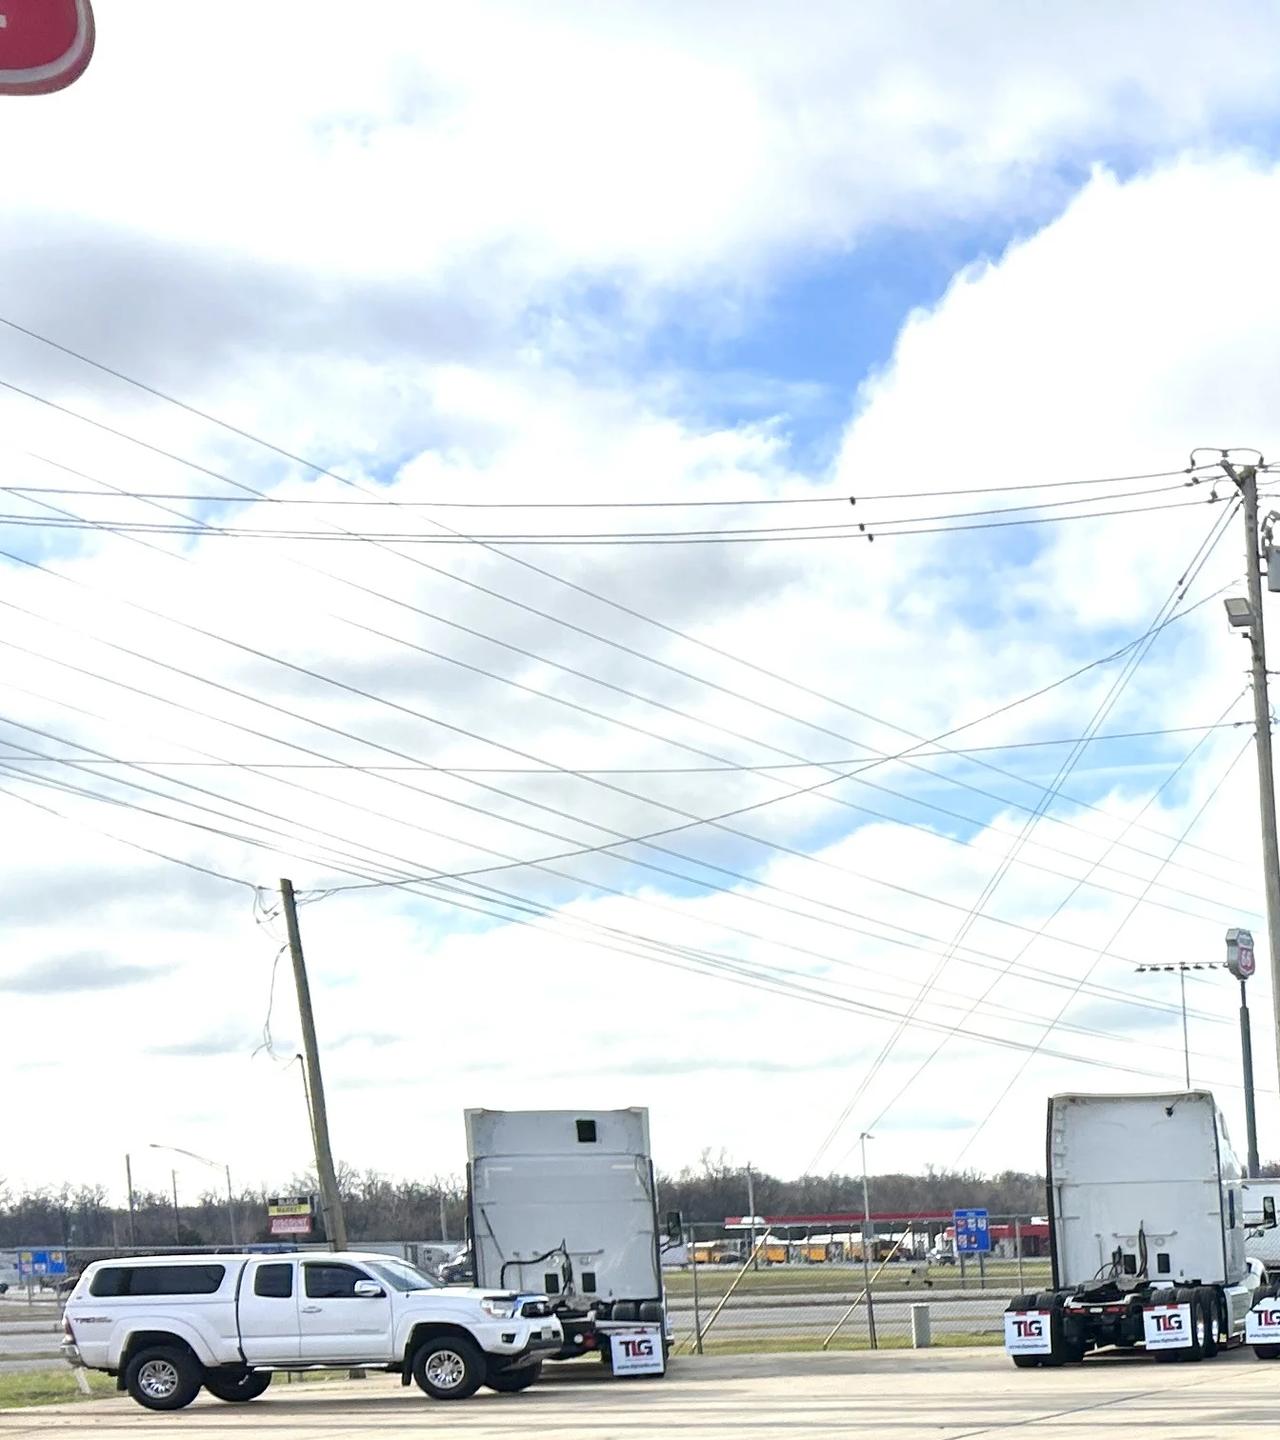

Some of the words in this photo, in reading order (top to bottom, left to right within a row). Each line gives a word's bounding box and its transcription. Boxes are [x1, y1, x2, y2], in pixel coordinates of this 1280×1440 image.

[1011, 1319, 1043, 1338] TLG
[1150, 1313, 1183, 1332] TLG
[619, 1339, 654, 1358] TLG
